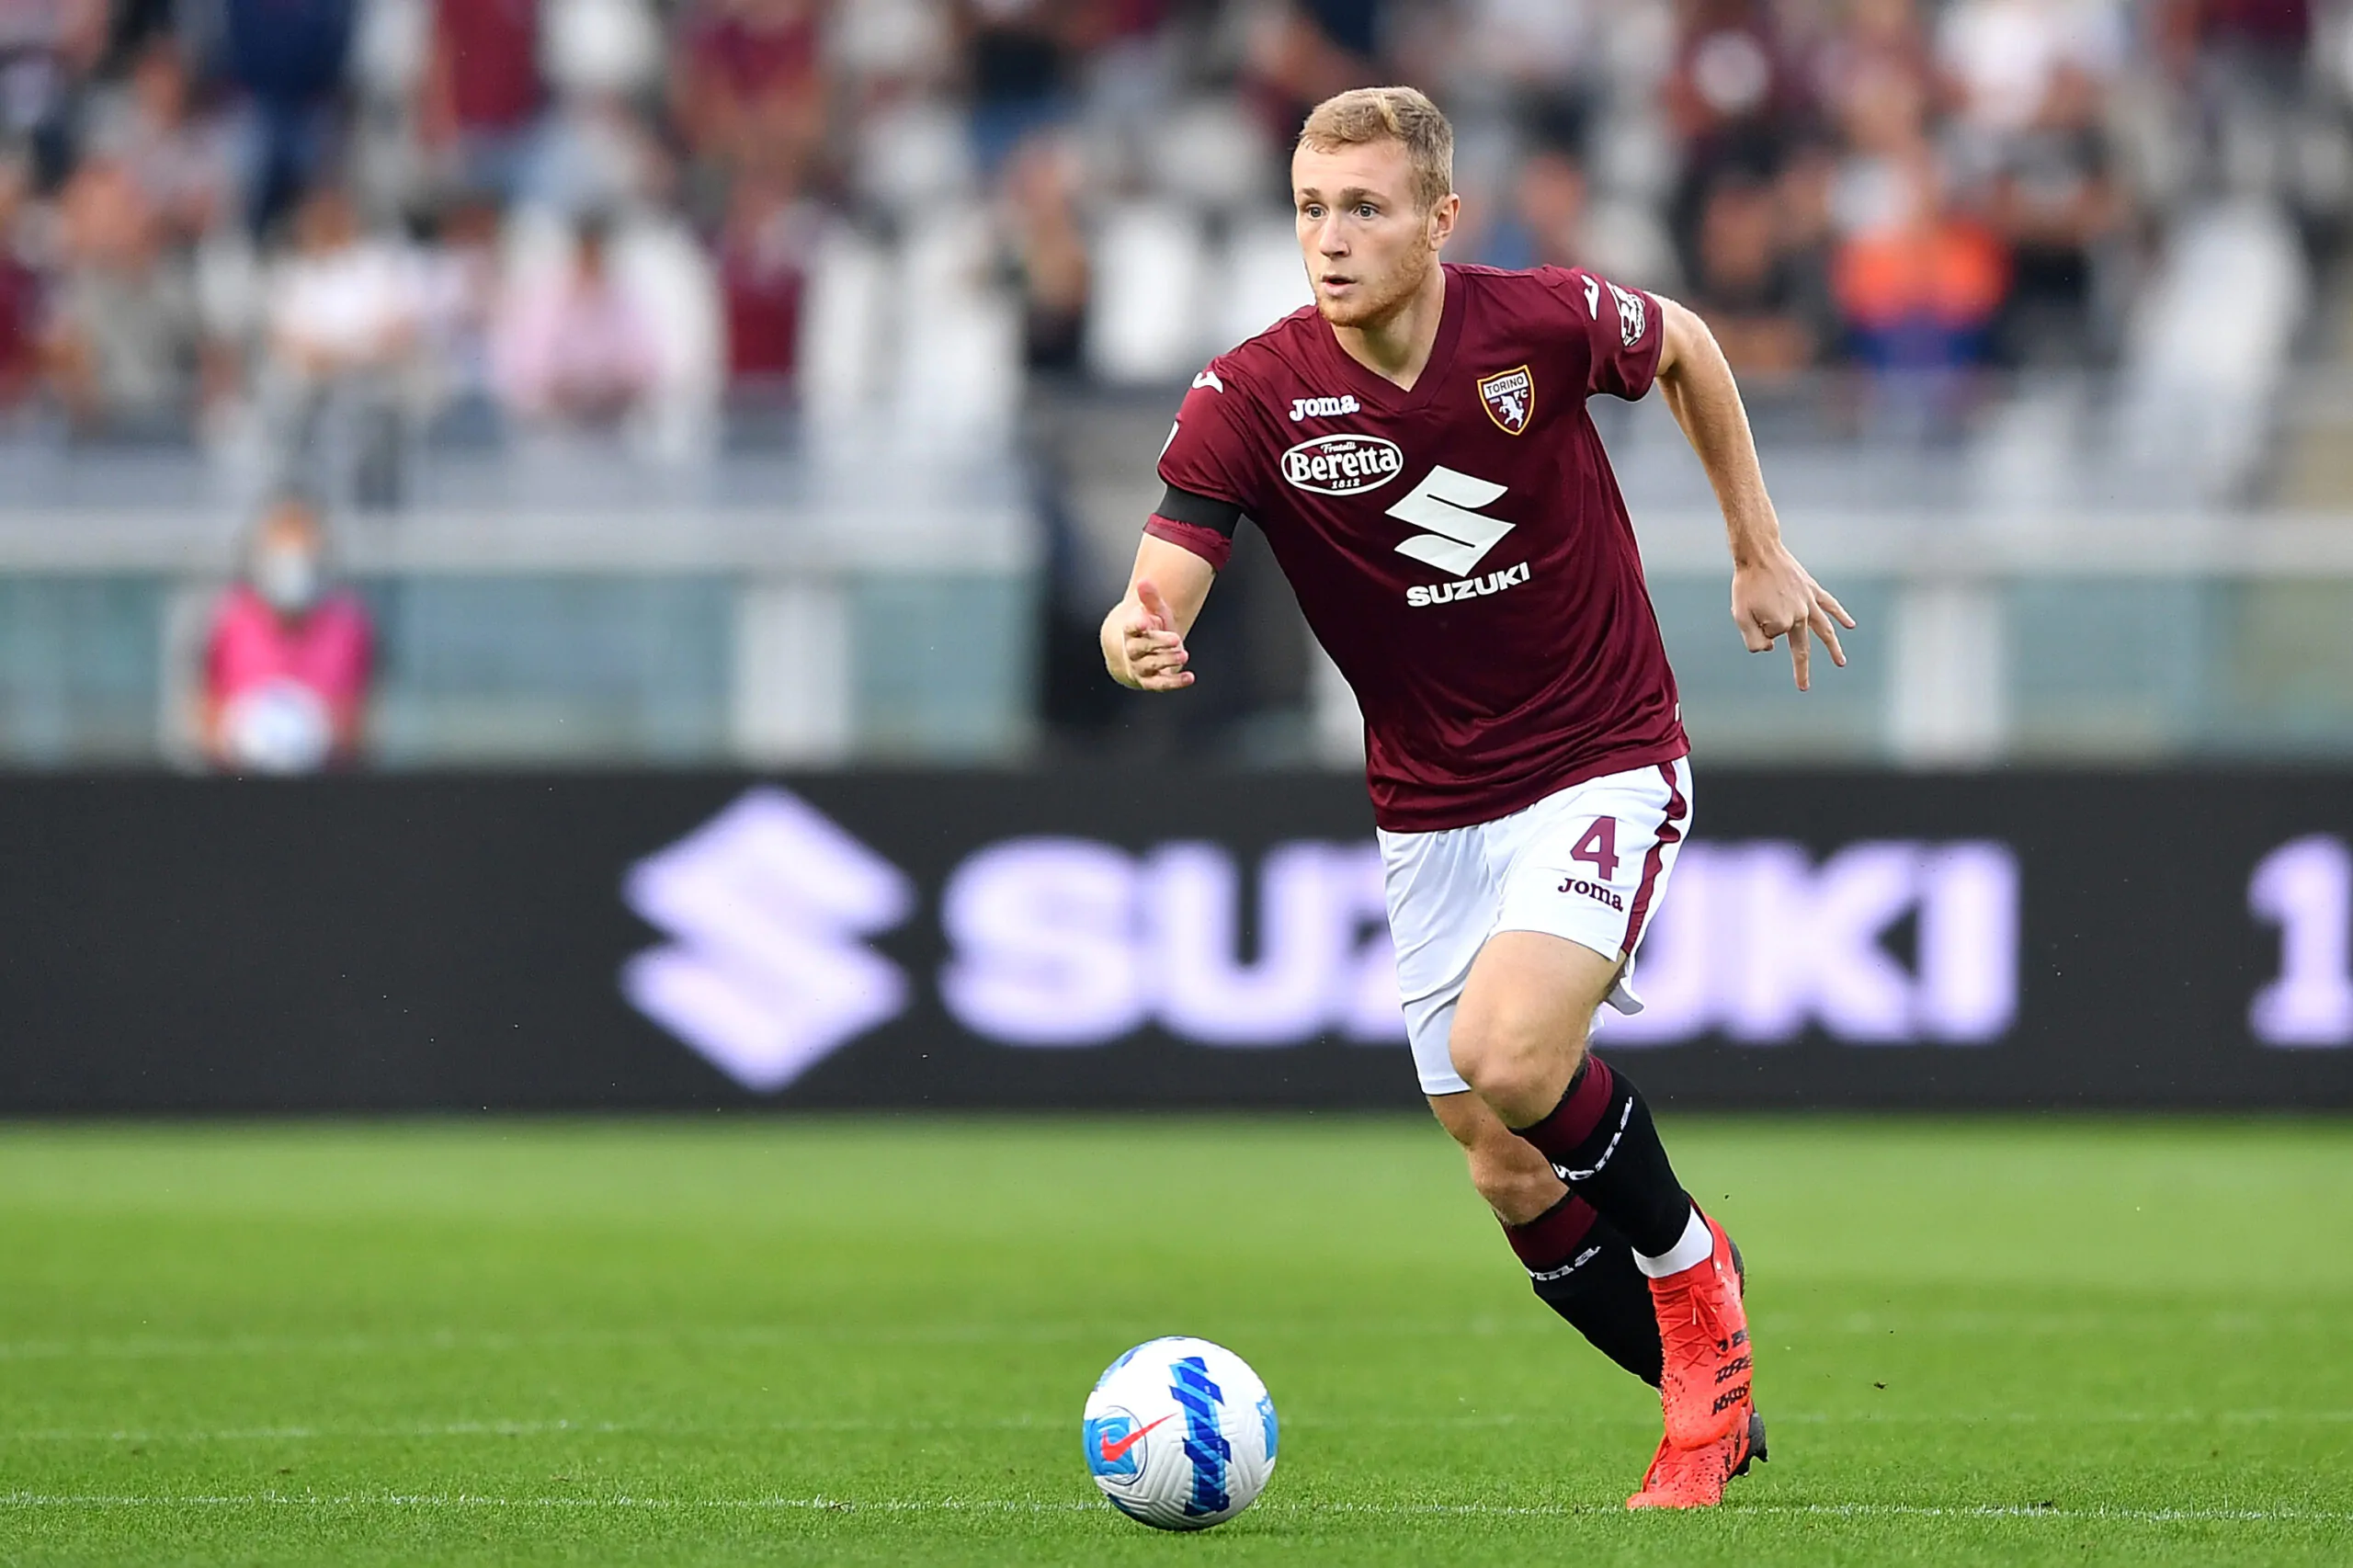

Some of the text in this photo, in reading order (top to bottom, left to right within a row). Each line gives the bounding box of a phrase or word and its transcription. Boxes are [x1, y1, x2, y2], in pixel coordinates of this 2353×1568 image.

[1485, 375, 1525, 395] TORINO
[1289, 446, 1400, 482] Beretta
[1331, 478, 1360, 489] 1812
[1406, 562, 1530, 607] SUZUKI
[1569, 814, 1620, 882] 4
